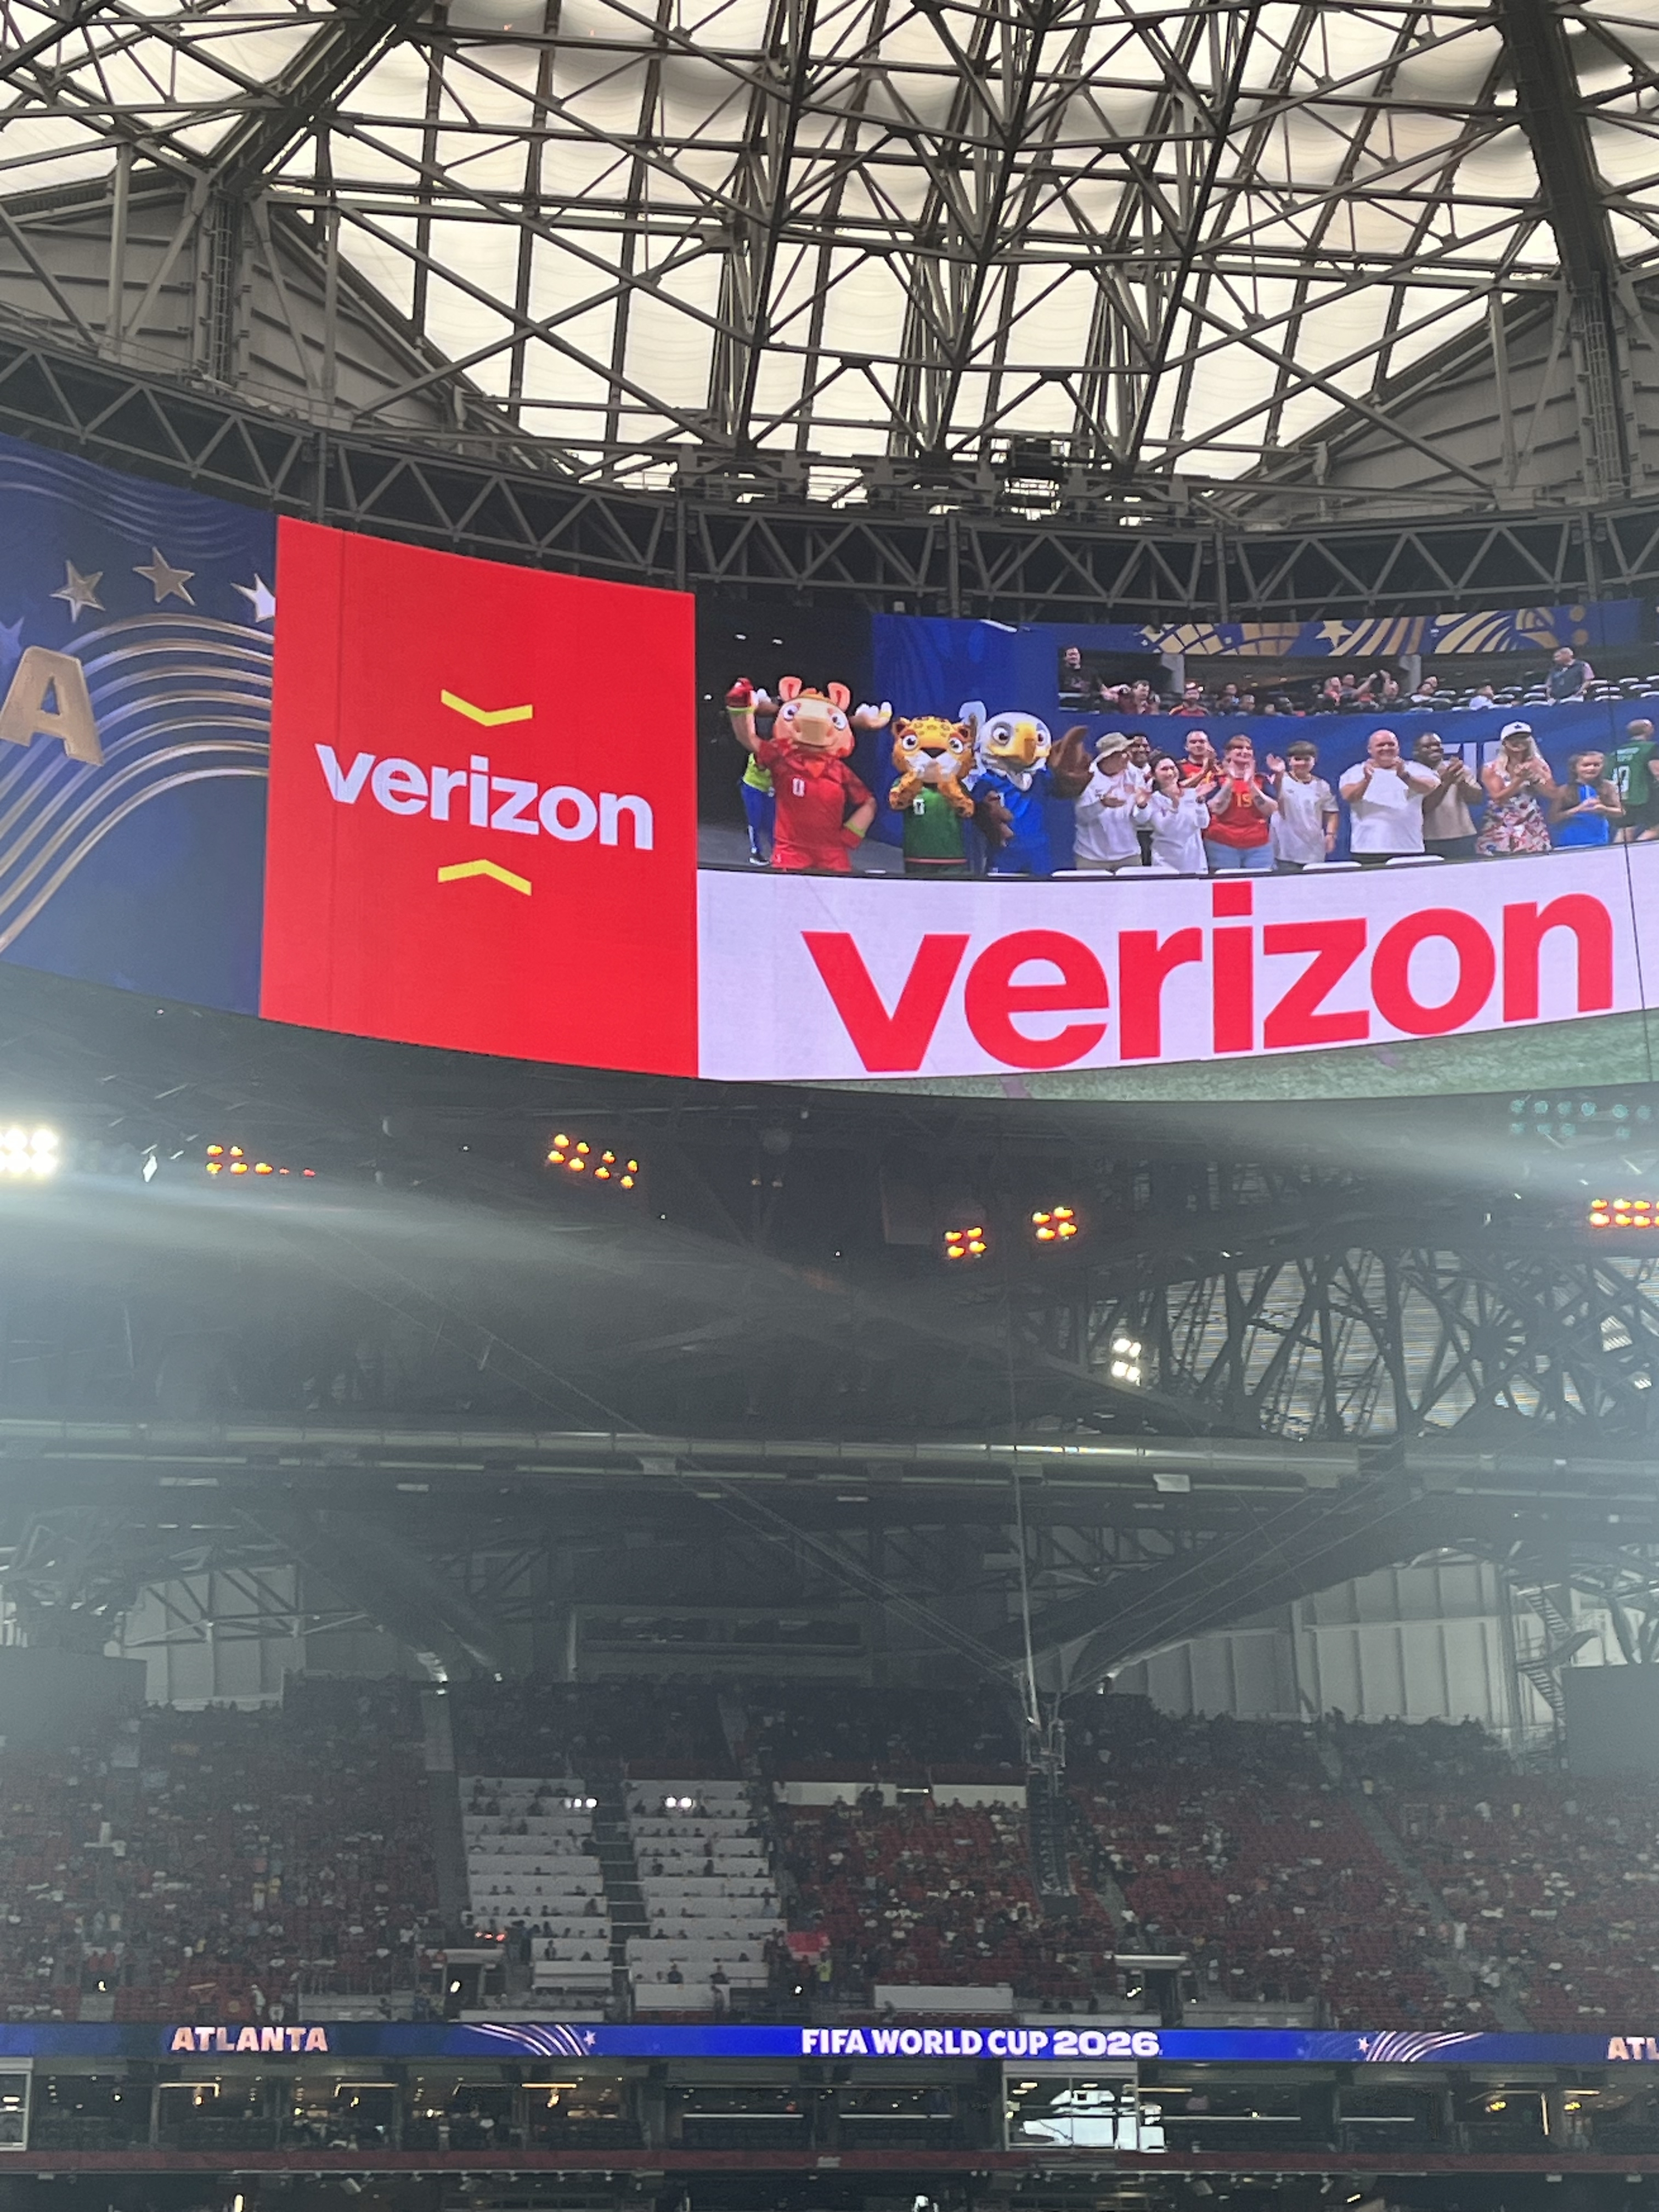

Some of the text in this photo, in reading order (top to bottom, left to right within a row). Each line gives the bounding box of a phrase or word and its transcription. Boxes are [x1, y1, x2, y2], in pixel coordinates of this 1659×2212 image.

[0, 646, 104, 766] A
[315, 743, 653, 850] verizon
[802, 881, 1613, 1073] verizon
[171, 2027, 328, 2052] ATLANTA
[802, 2029, 1160, 2057] FIFA WORLD CUP 2026
